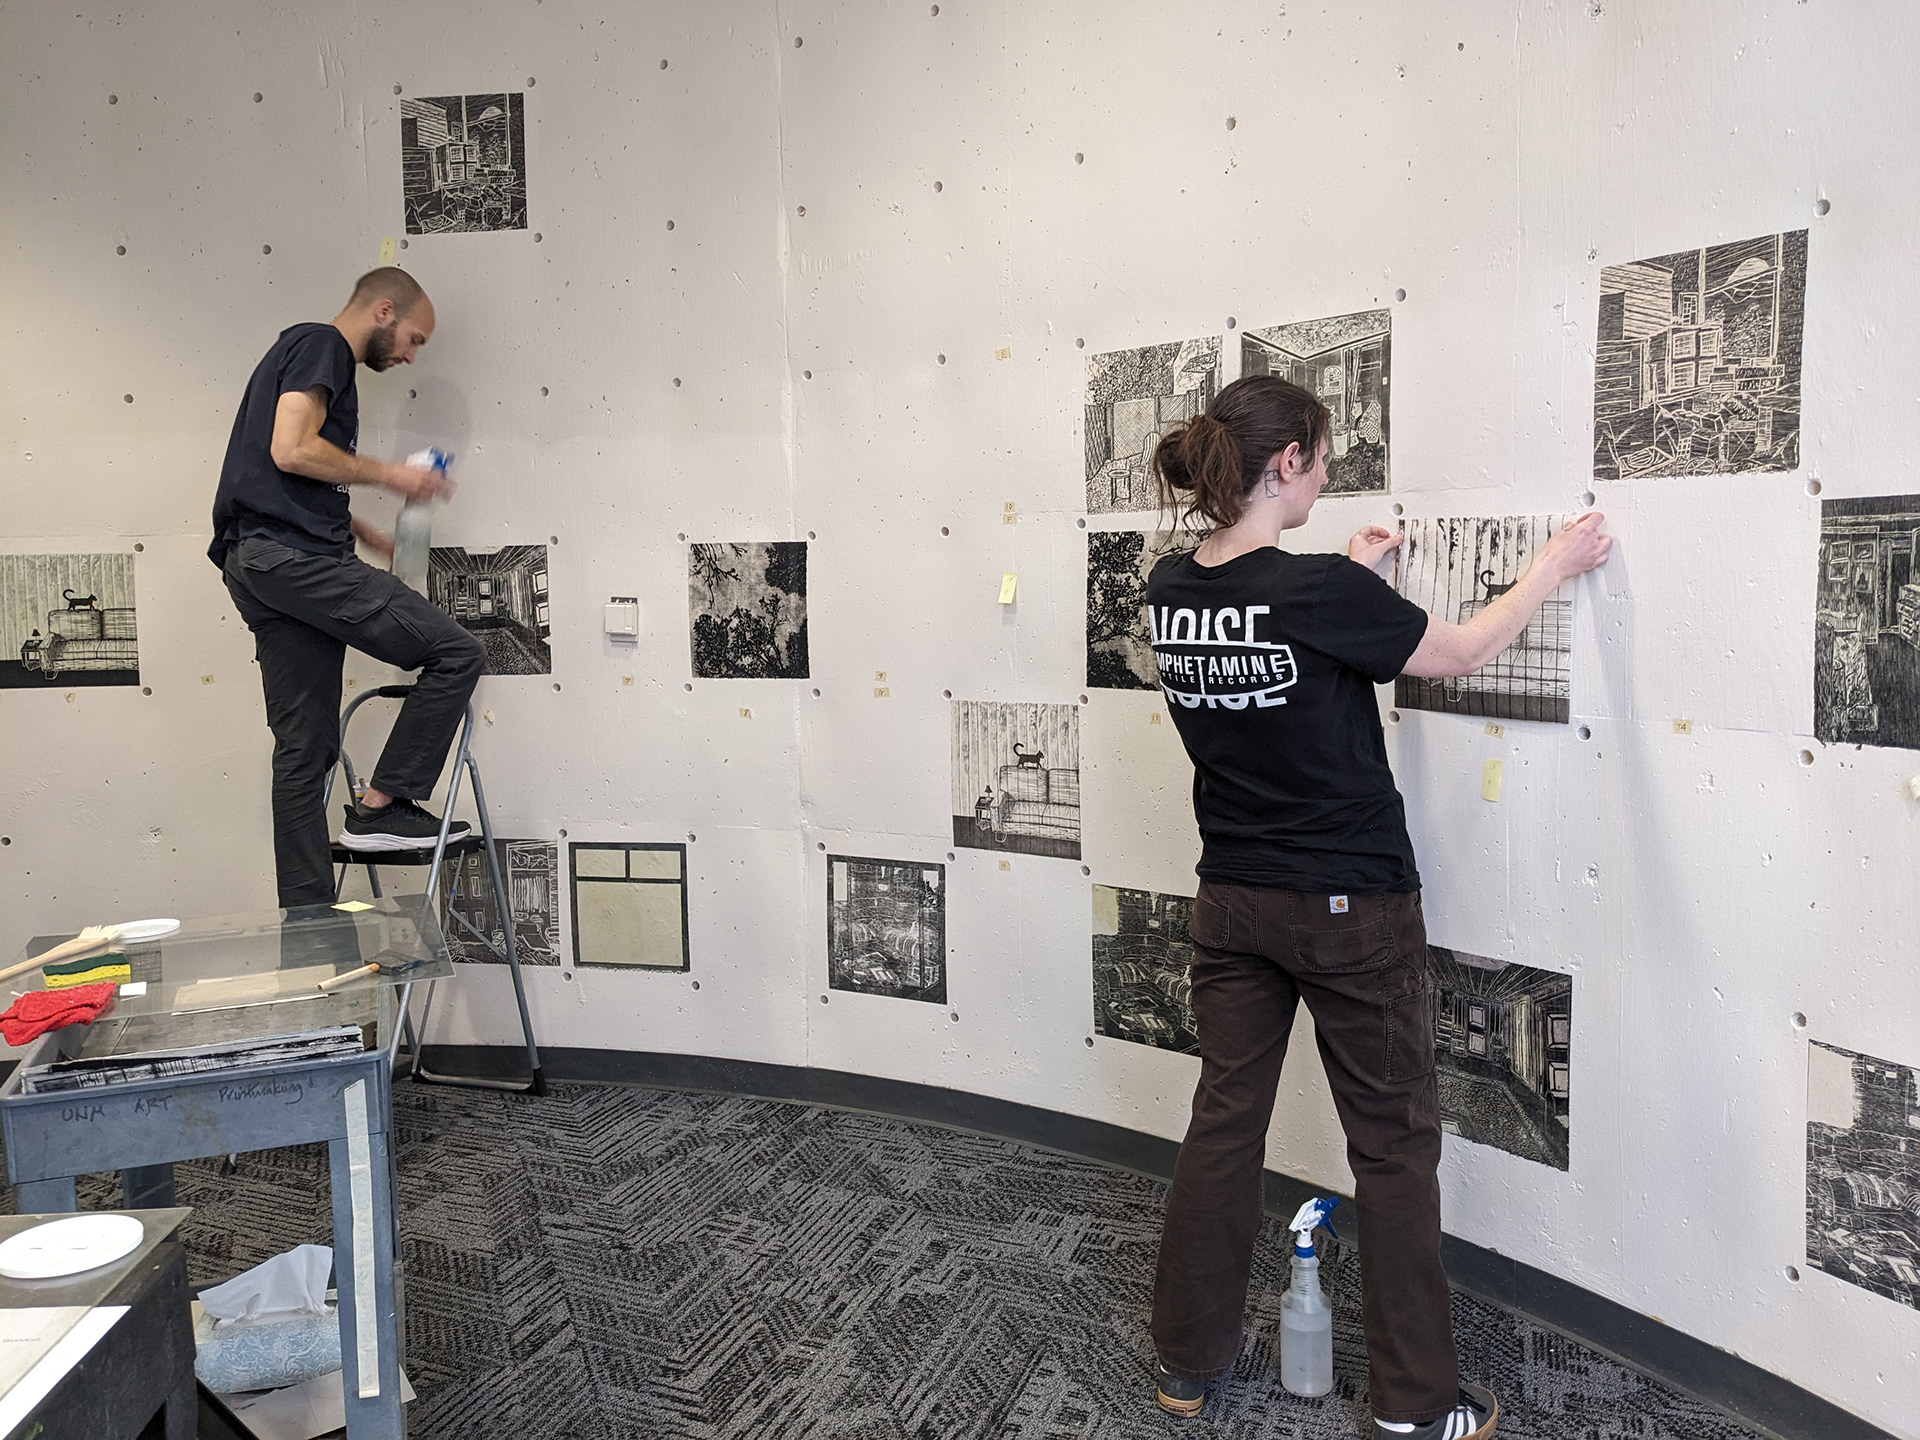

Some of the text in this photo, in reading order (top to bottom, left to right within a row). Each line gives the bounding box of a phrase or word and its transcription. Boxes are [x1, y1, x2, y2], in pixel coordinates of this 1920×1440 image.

[1156, 651, 1286, 677] MPHETAMINE
[1208, 673, 1284, 685] RECORDS
[62, 1105, 106, 1122] UNM
[134, 1095, 173, 1117] ART
